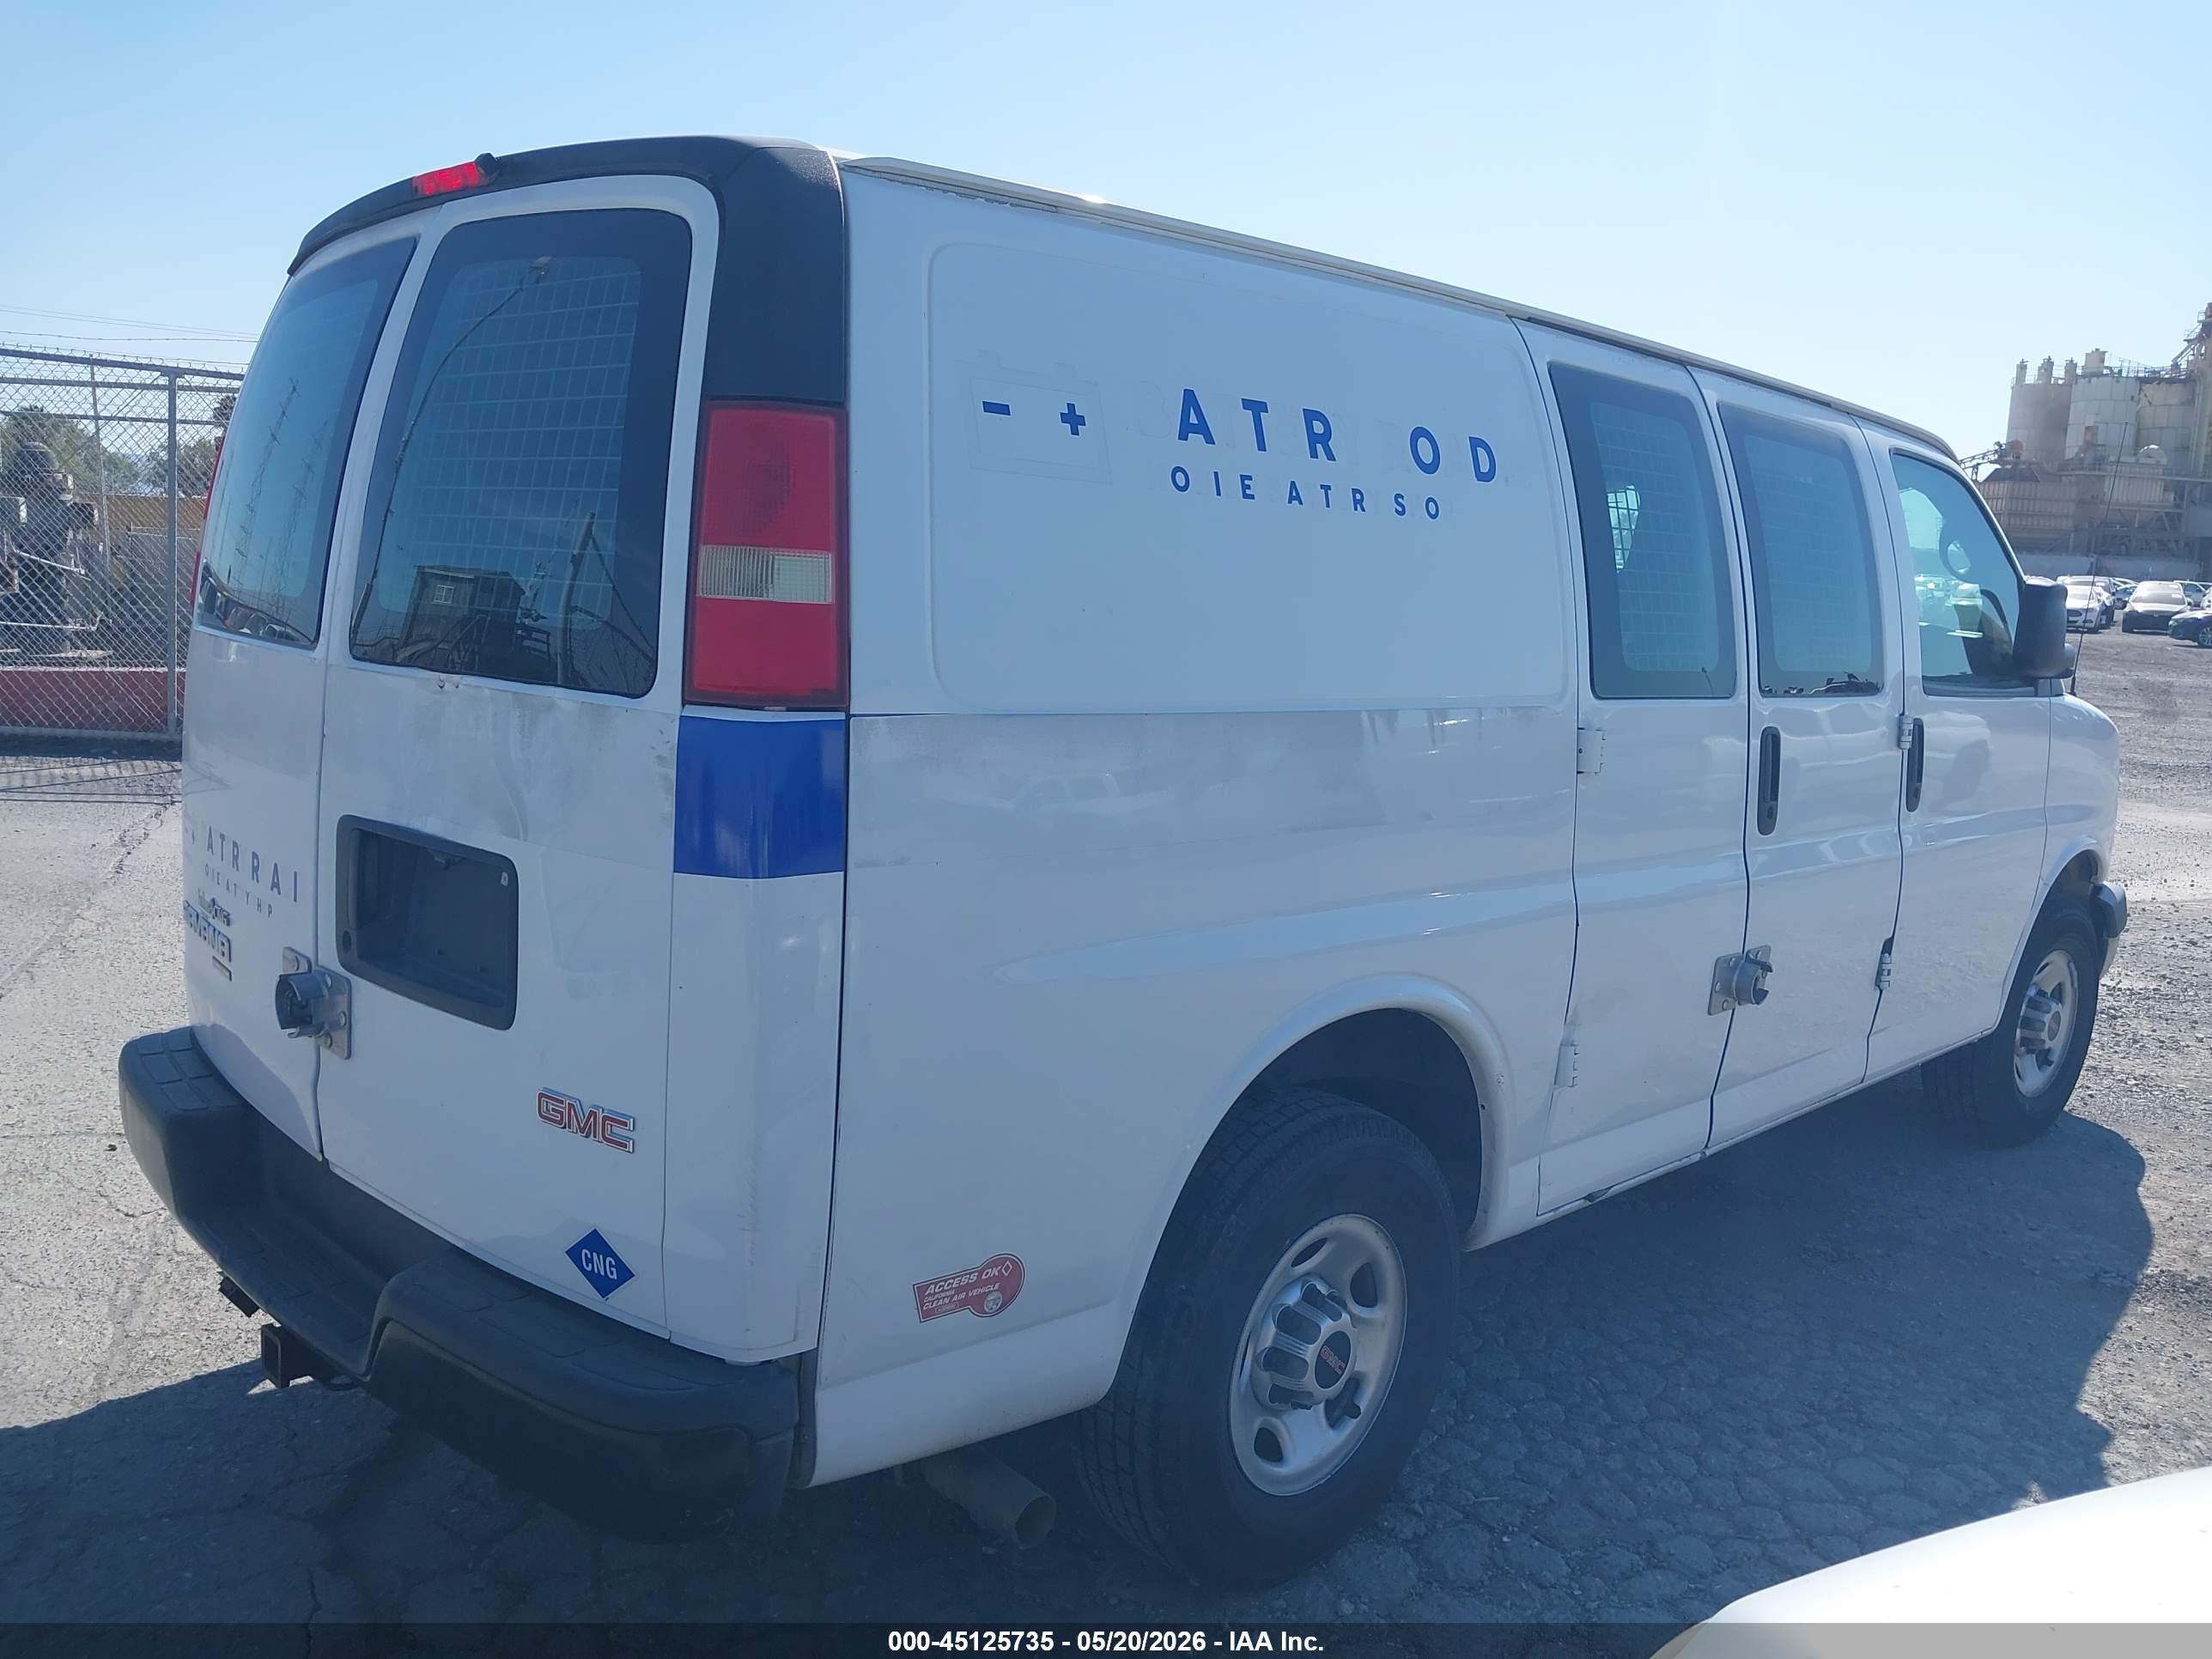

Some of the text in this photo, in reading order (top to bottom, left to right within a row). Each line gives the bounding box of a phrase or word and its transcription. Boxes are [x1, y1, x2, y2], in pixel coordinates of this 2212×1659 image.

[536, 1086, 635, 1153] GMC
[580, 1248, 618, 1280] CNG
[922, 1296, 951, 1310] CLEAN
[951, 1291, 966, 1303] AIR
[969, 1282, 1001, 1297] VEHICLE
[924, 1266, 1002, 1296] ACCESS OK
[1320, 1345, 1346, 1376] GMC
